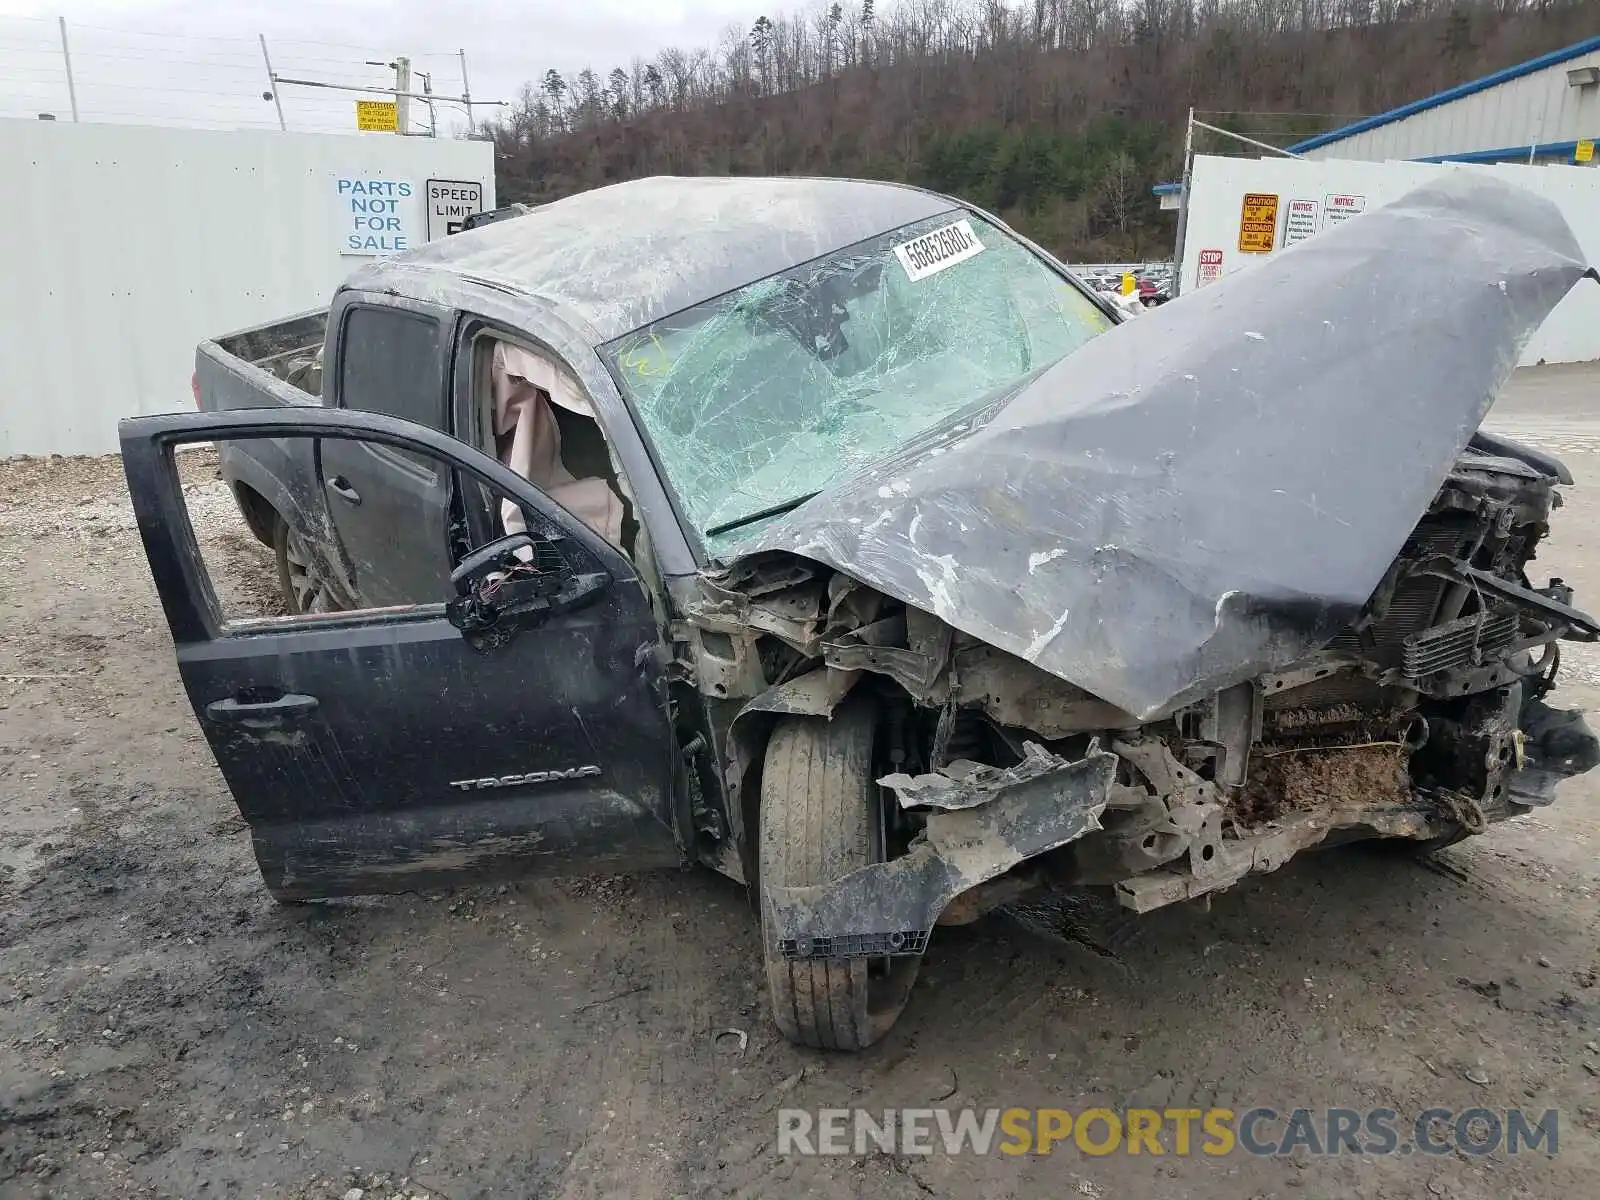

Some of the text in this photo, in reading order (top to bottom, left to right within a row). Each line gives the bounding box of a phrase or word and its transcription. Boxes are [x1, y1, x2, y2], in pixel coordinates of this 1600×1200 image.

[338, 180, 412, 197] PARTS
[431, 188, 478, 201] SPEED
[352, 198, 399, 213] NOT
[1247, 197, 1277, 206] CAUTION
[1292, 202, 1313, 212] NOTICE
[1334, 197, 1354, 206] NOTICE
[436, 204, 473, 217] LIMIT
[354, 216, 402, 231] FOR
[1244, 223, 1273, 232] CUIDADO
[348, 235, 407, 250] SALE
[904, 225, 969, 270] 56852680
[1201, 251, 1222, 263] STOP
[449, 764, 602, 791] TACOMA
